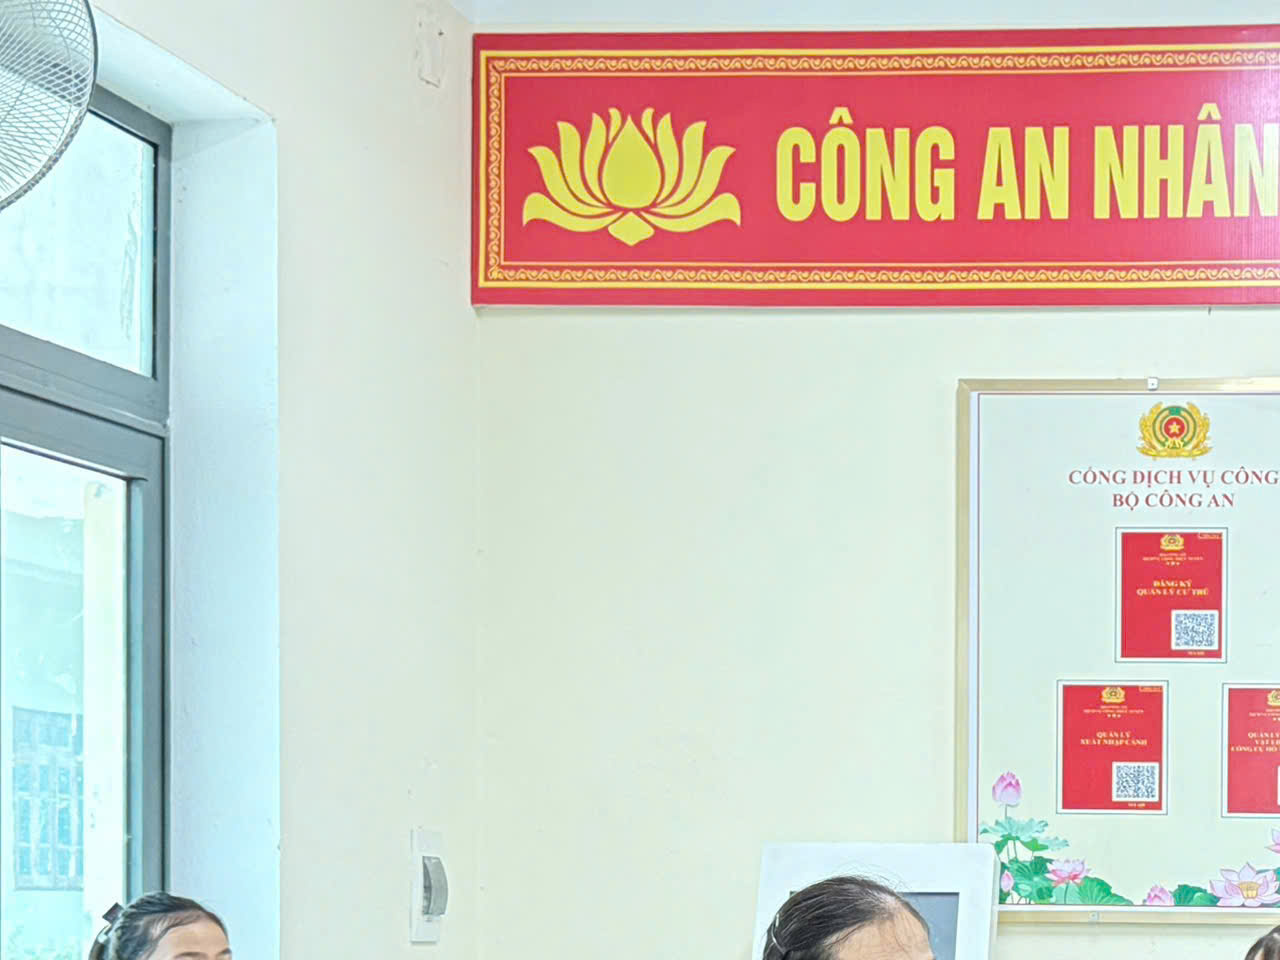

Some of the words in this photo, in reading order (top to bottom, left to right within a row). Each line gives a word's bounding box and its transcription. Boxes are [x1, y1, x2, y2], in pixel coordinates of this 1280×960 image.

[776, 107, 954, 222] CÔNG
[977, 127, 1069, 220] AN
[1094, 102, 1278, 218] NHÂN
[1132, 470, 1182, 488] DỊCH
[1187, 470, 1215, 488] VỤ
[1220, 466, 1280, 485] CÔNG
[1112, 491, 1139, 511] BỘ
[1144, 489, 1203, 508] CÔNG
[1207, 493, 1235, 508] AN
